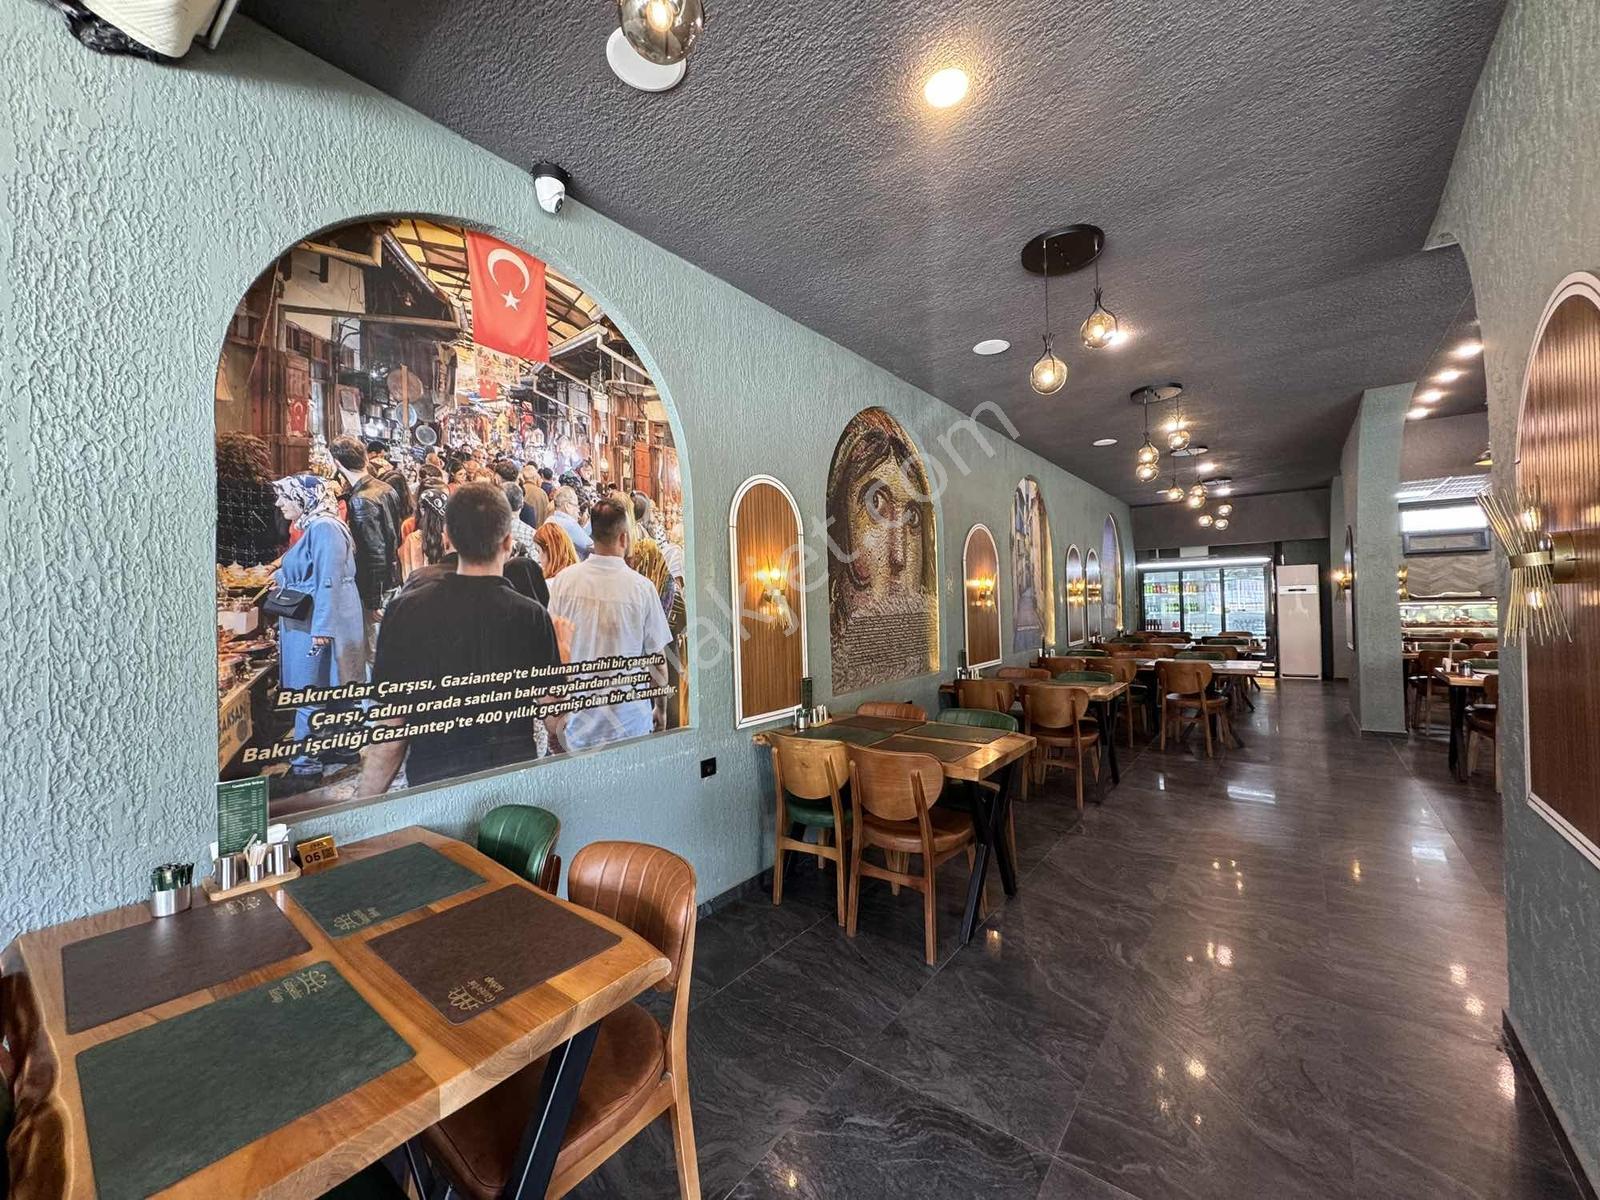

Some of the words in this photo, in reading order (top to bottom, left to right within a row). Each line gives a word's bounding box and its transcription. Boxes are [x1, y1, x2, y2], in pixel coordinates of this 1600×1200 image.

[277, 684, 374, 706] Bakırcılar
[378, 680, 437, 698] Çarşısı,
[441, 668, 529, 688] Gaziantep'te
[531, 663, 580, 678] bulunan
[581, 659, 610, 673] tarihi
[612, 657, 626, 669] bir
[627, 654, 665, 668] çarşıdır.
[311, 710, 365, 729] Çarşı,
[369, 703, 413, 719] adını
[416, 694, 461, 712] orada
[464, 690, 512, 708] satılan
[514, 684, 548, 699] bakır
[549, 677, 610, 698] eşyalardan
[611, 672, 651, 687] almıştır.
[242, 742, 301, 763] Bakır
[306, 731, 368, 755] işciliği
[372, 716, 473, 742] Gaziantep'te
[476, 711, 503, 725] 400
[505, 705, 538, 724] yıllık
[540, 699, 584, 718] geçmişi
[585, 693, 609, 708] olan
[610, 692, 624, 704] bir
[626, 690, 636, 702] el
[636, 685, 678, 700] sanatıdır.
